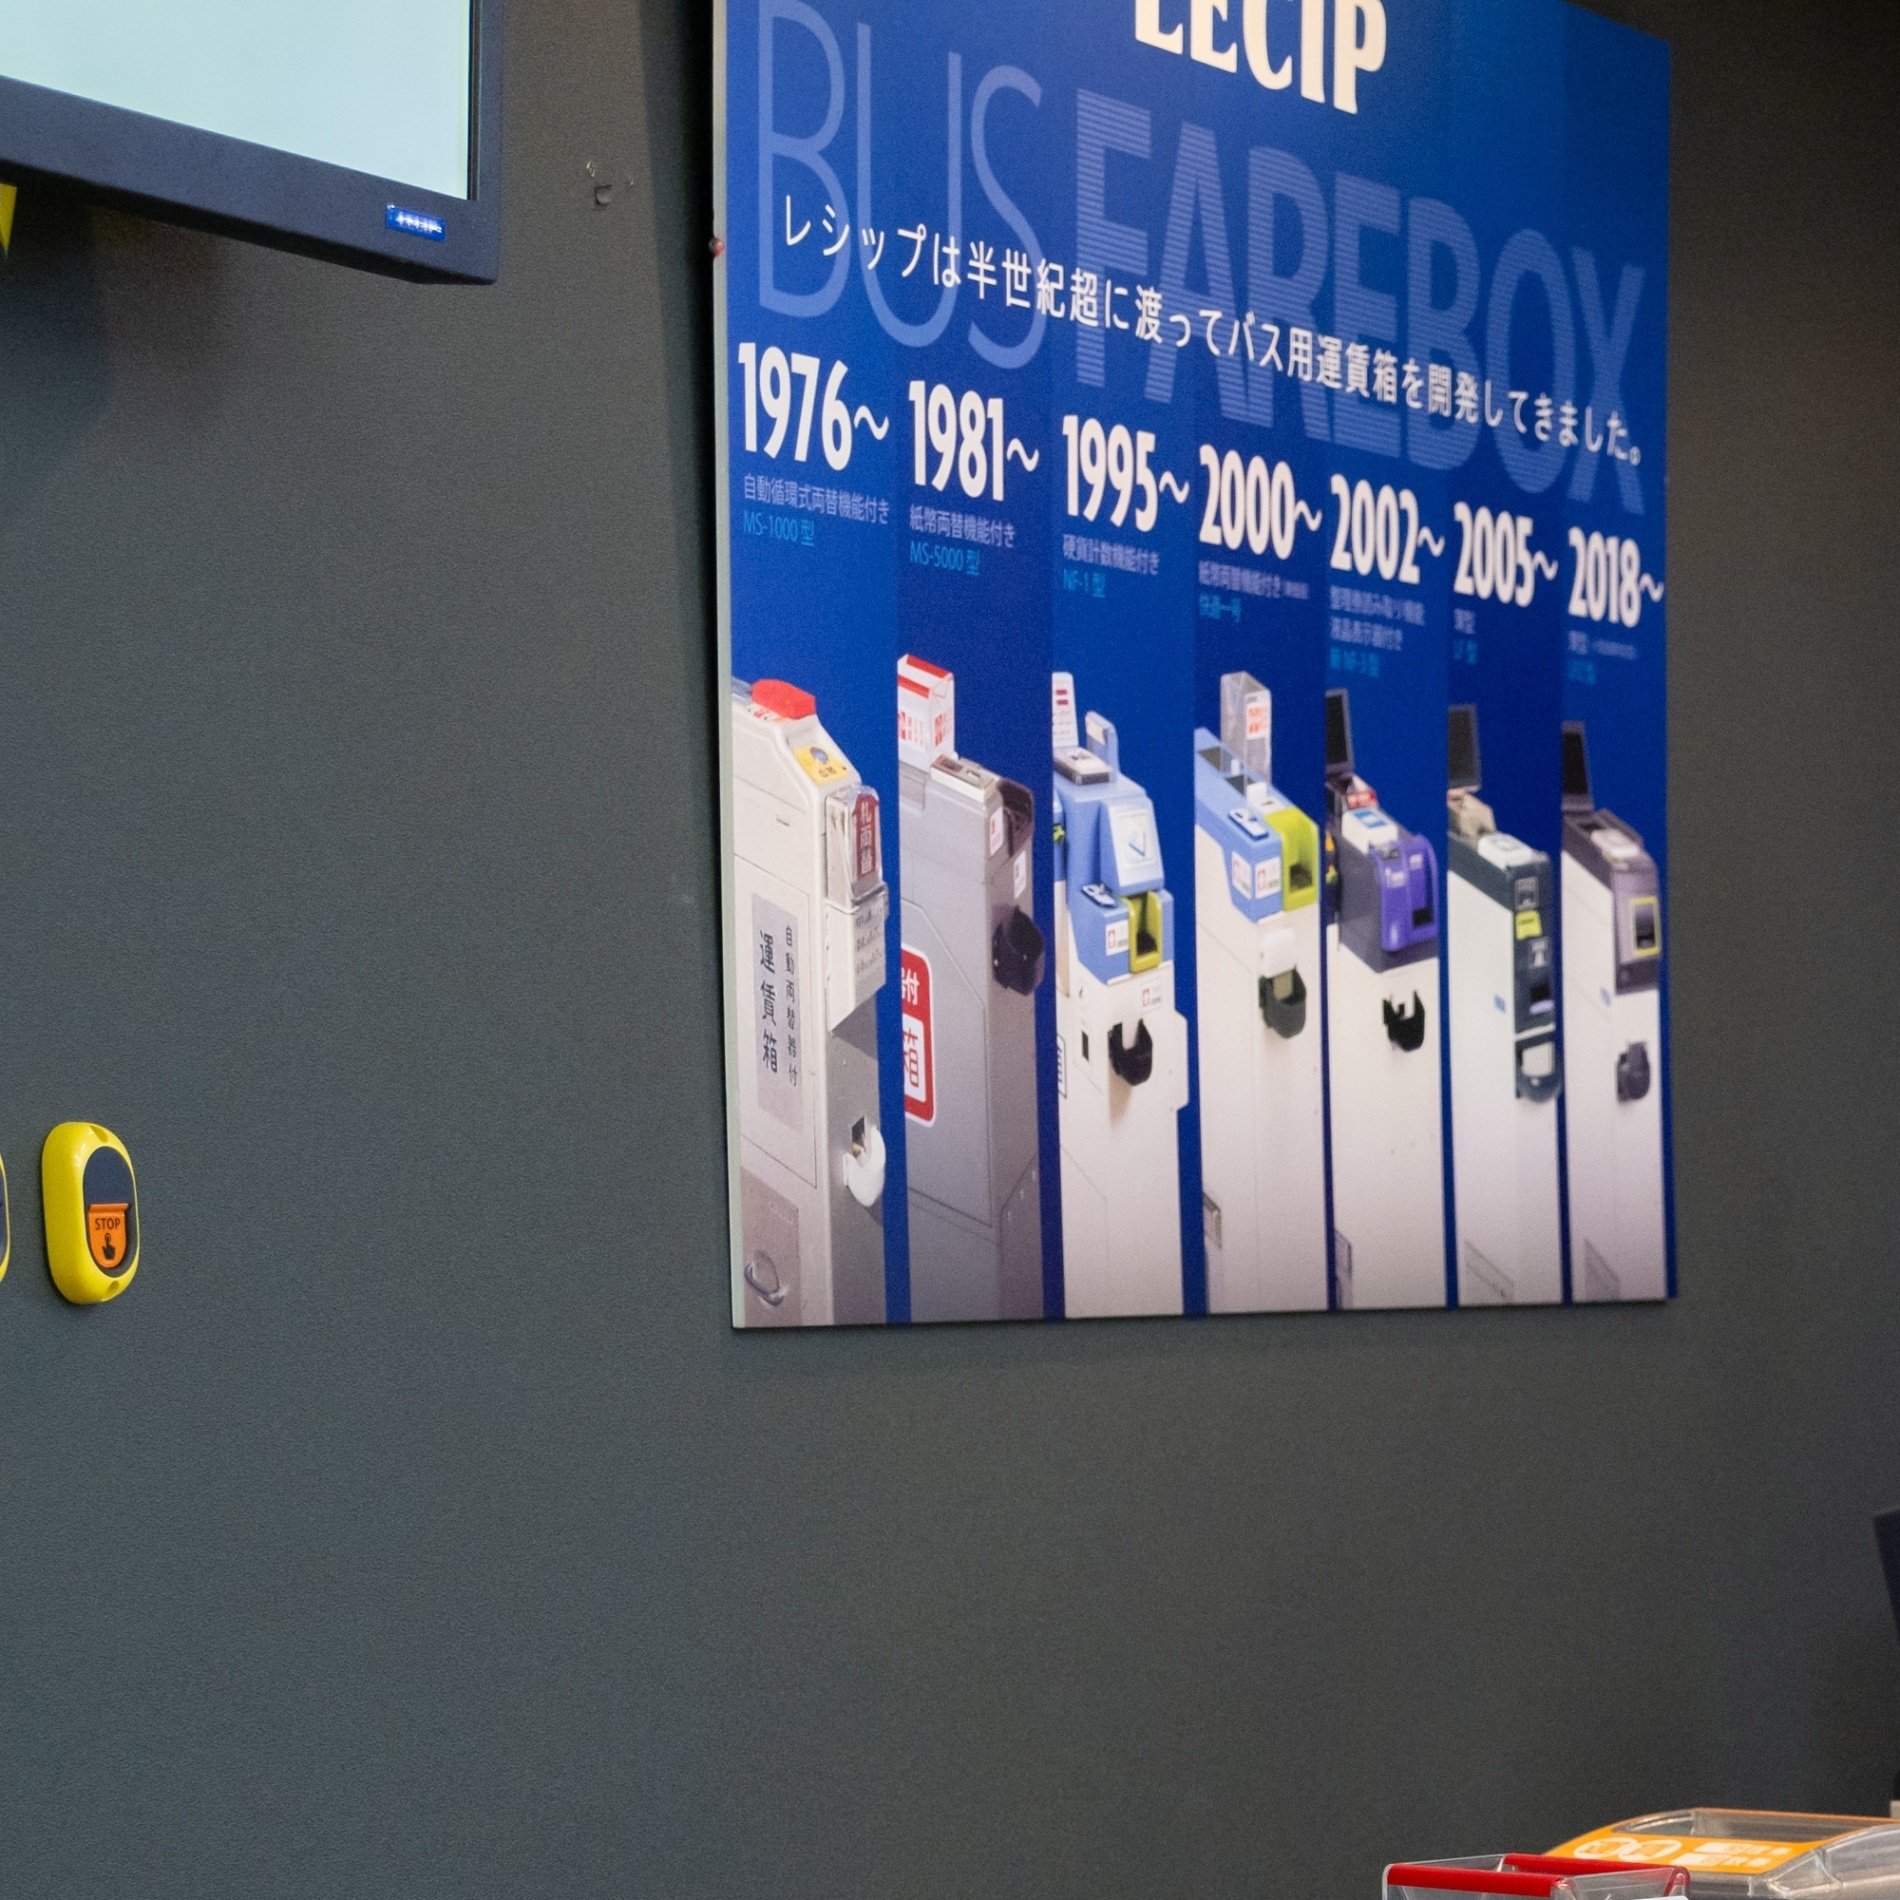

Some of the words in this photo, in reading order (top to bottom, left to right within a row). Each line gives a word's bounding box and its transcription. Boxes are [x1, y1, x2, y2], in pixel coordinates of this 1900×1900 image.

[785, 195, 1641, 466] レシップは半世紀超に渡ってバス用運賃箱を開発してきました。
[743, 510, 798, 542] MS-1000
[94, 1217, 121, 1231] STOP
